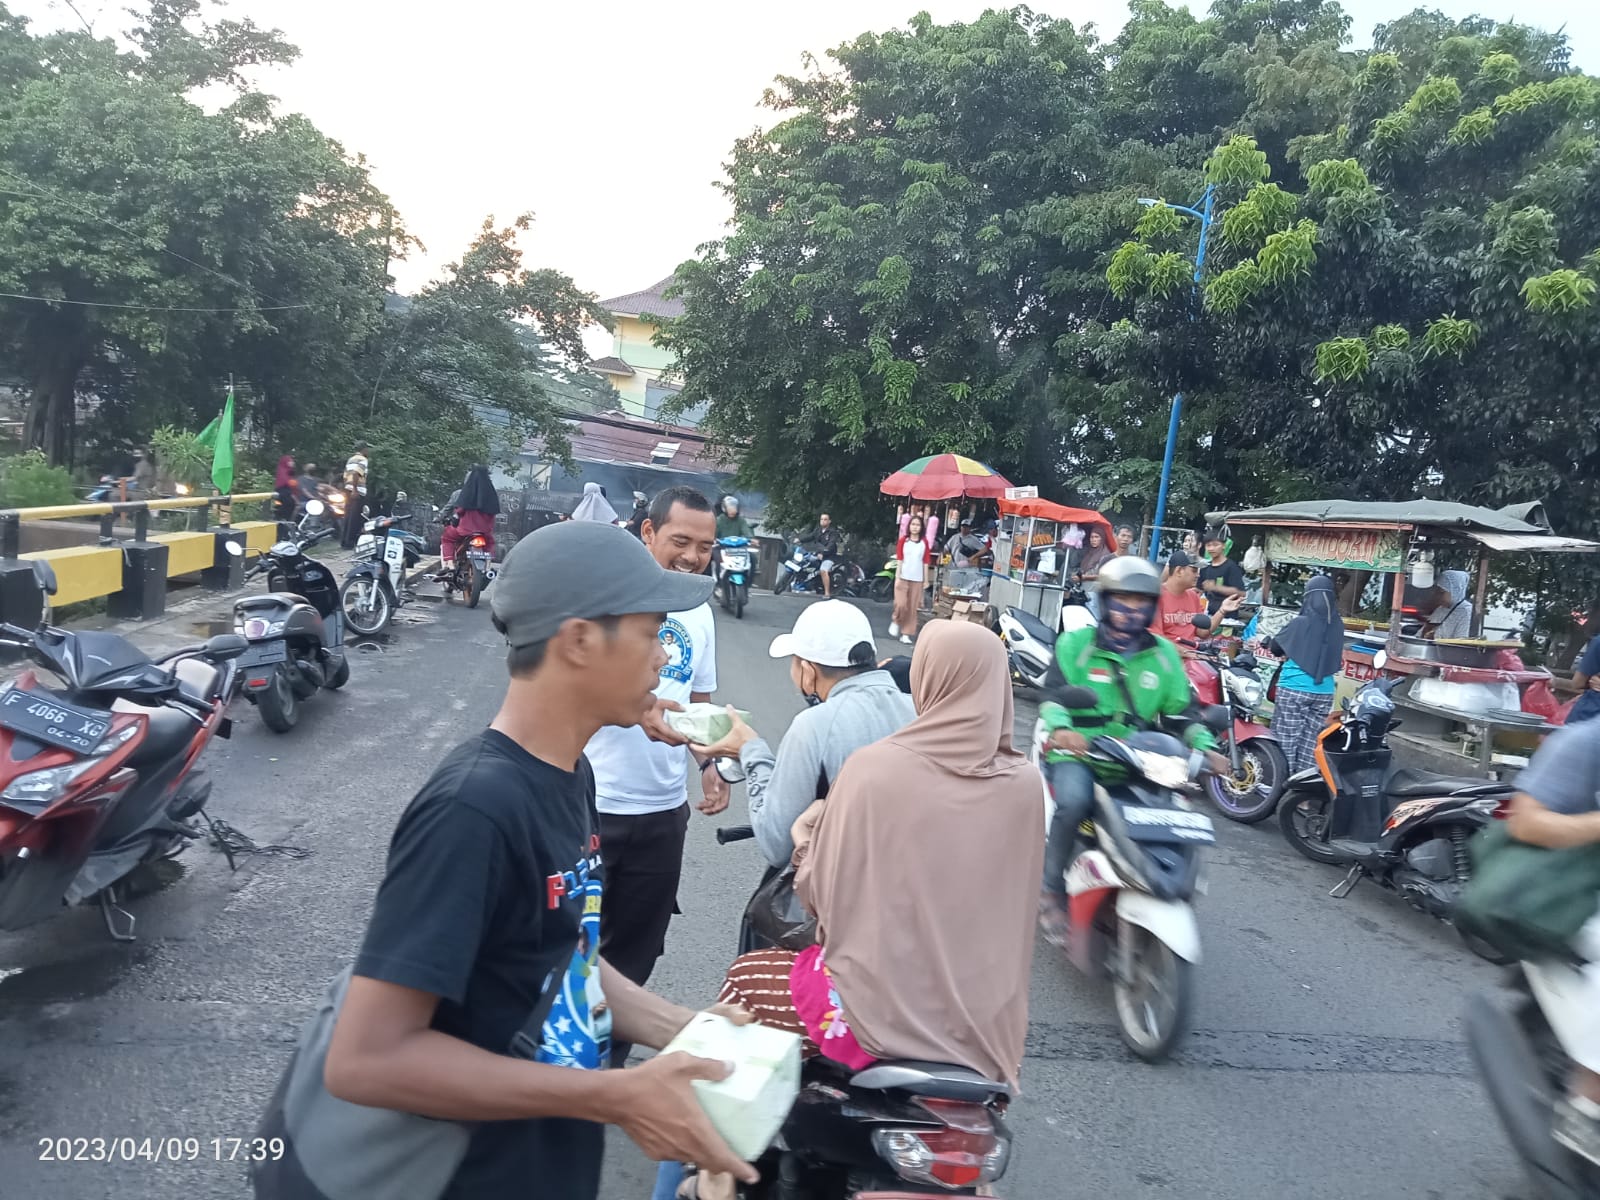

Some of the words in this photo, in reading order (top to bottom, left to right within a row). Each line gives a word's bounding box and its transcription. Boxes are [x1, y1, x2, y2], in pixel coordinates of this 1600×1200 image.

[4, 694, 22, 706] F
[26, 703, 68, 723] 4066
[46, 727, 90, 746] 04-20
